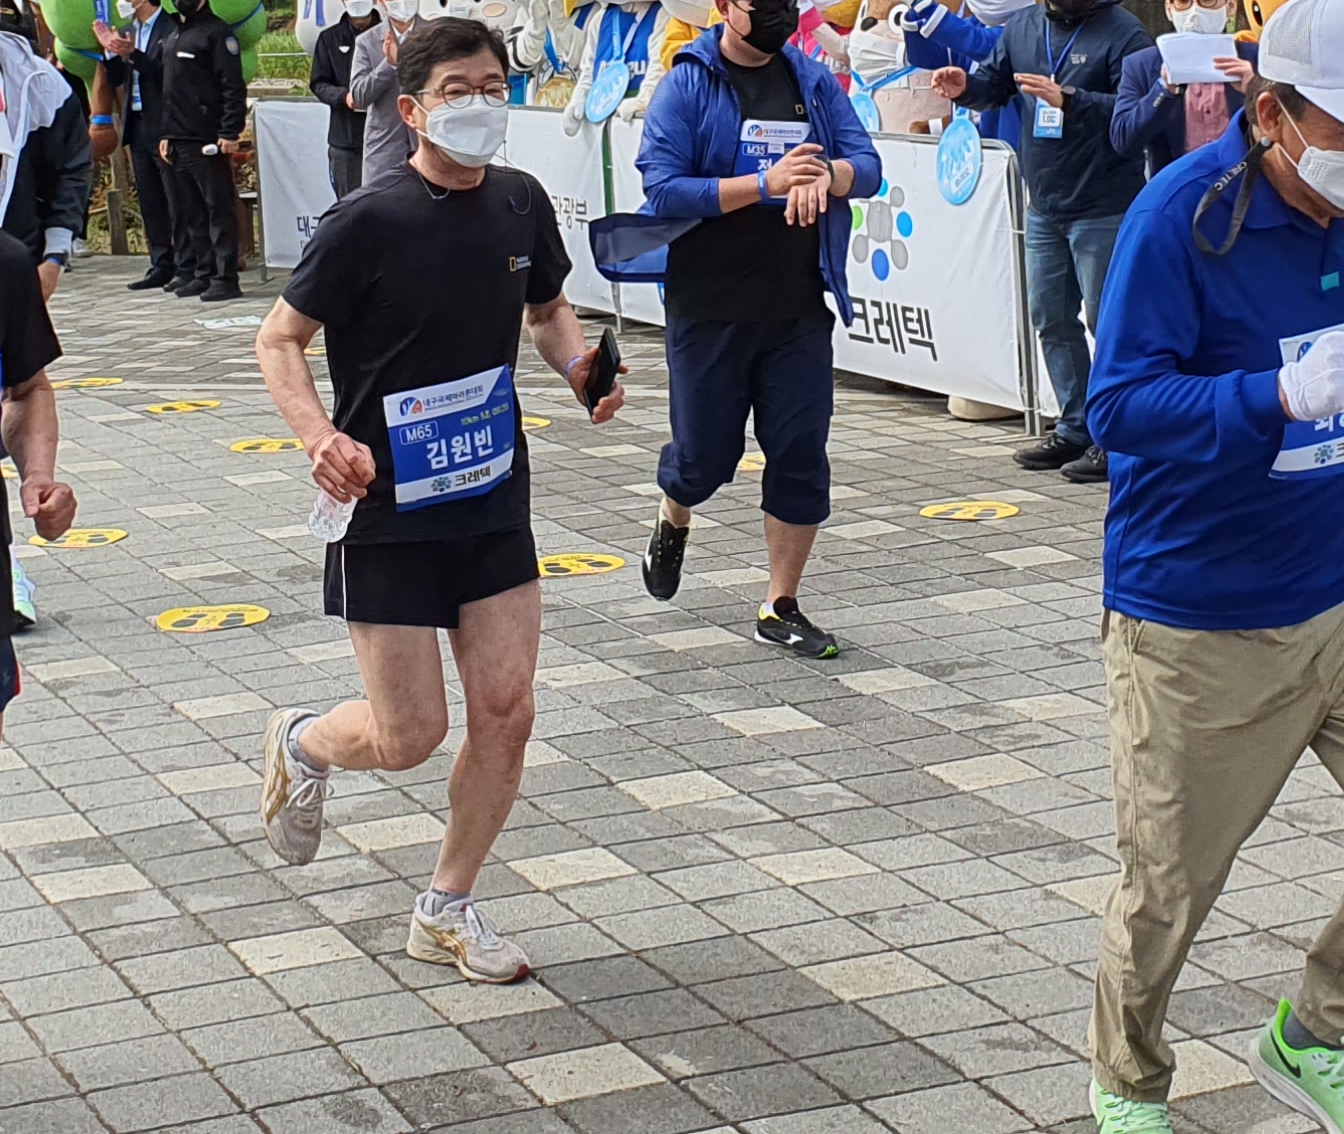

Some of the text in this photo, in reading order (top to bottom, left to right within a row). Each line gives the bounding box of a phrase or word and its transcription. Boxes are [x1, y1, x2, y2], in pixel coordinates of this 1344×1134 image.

[847, 295, 938, 362] 크레텍
[406, 424, 433, 444] M65
[426, 424, 494, 470] 김원빈
